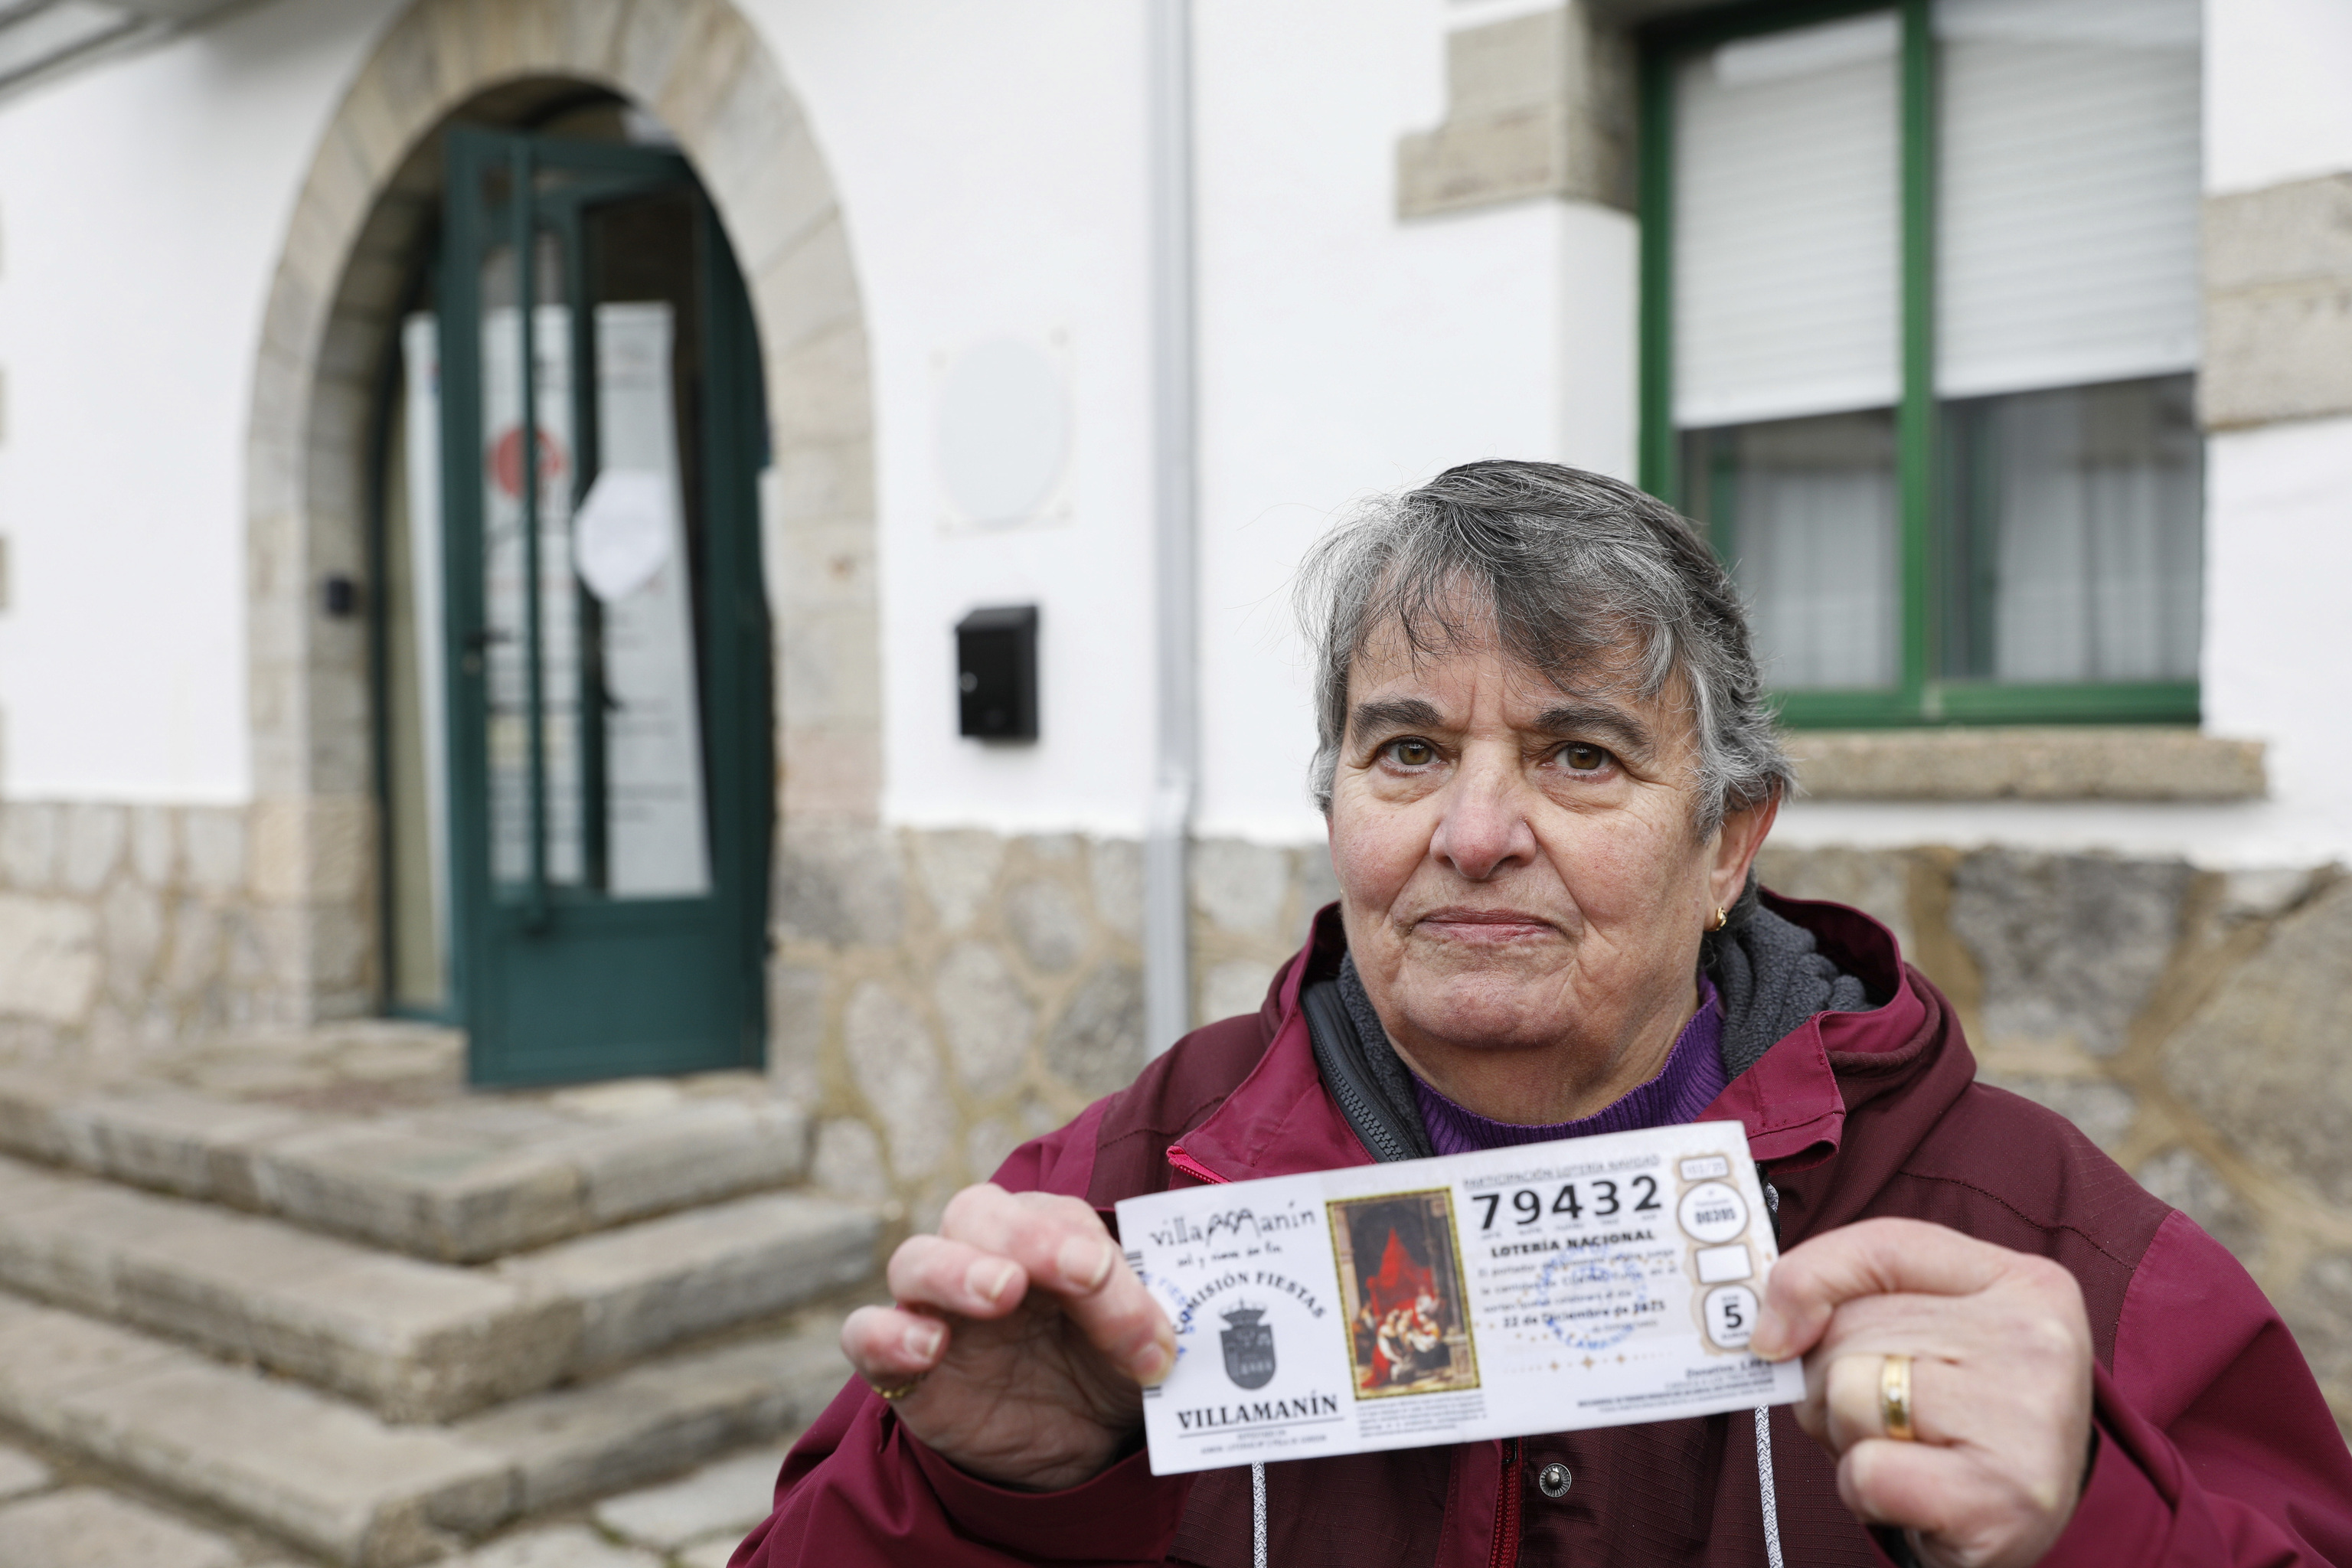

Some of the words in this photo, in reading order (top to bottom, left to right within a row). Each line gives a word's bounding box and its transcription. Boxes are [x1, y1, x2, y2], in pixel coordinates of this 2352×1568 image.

[1472, 1174, 1661, 1230] 79432
[1491, 1237, 1560, 1259] LOTERÍA
[1568, 1230, 1655, 1250] NACIONAL
[1174, 1270, 1250, 1334] COMISIÓN
[1256, 1271, 1327, 1318] FIESTAS
[1522, 1314, 1537, 1327] de
[1541, 1306, 1609, 1325] Diciembre
[1614, 1305, 1628, 1316] de
[1724, 1302, 1743, 1330] 5
[1177, 1389, 1339, 1430] VILLAMANÍN
